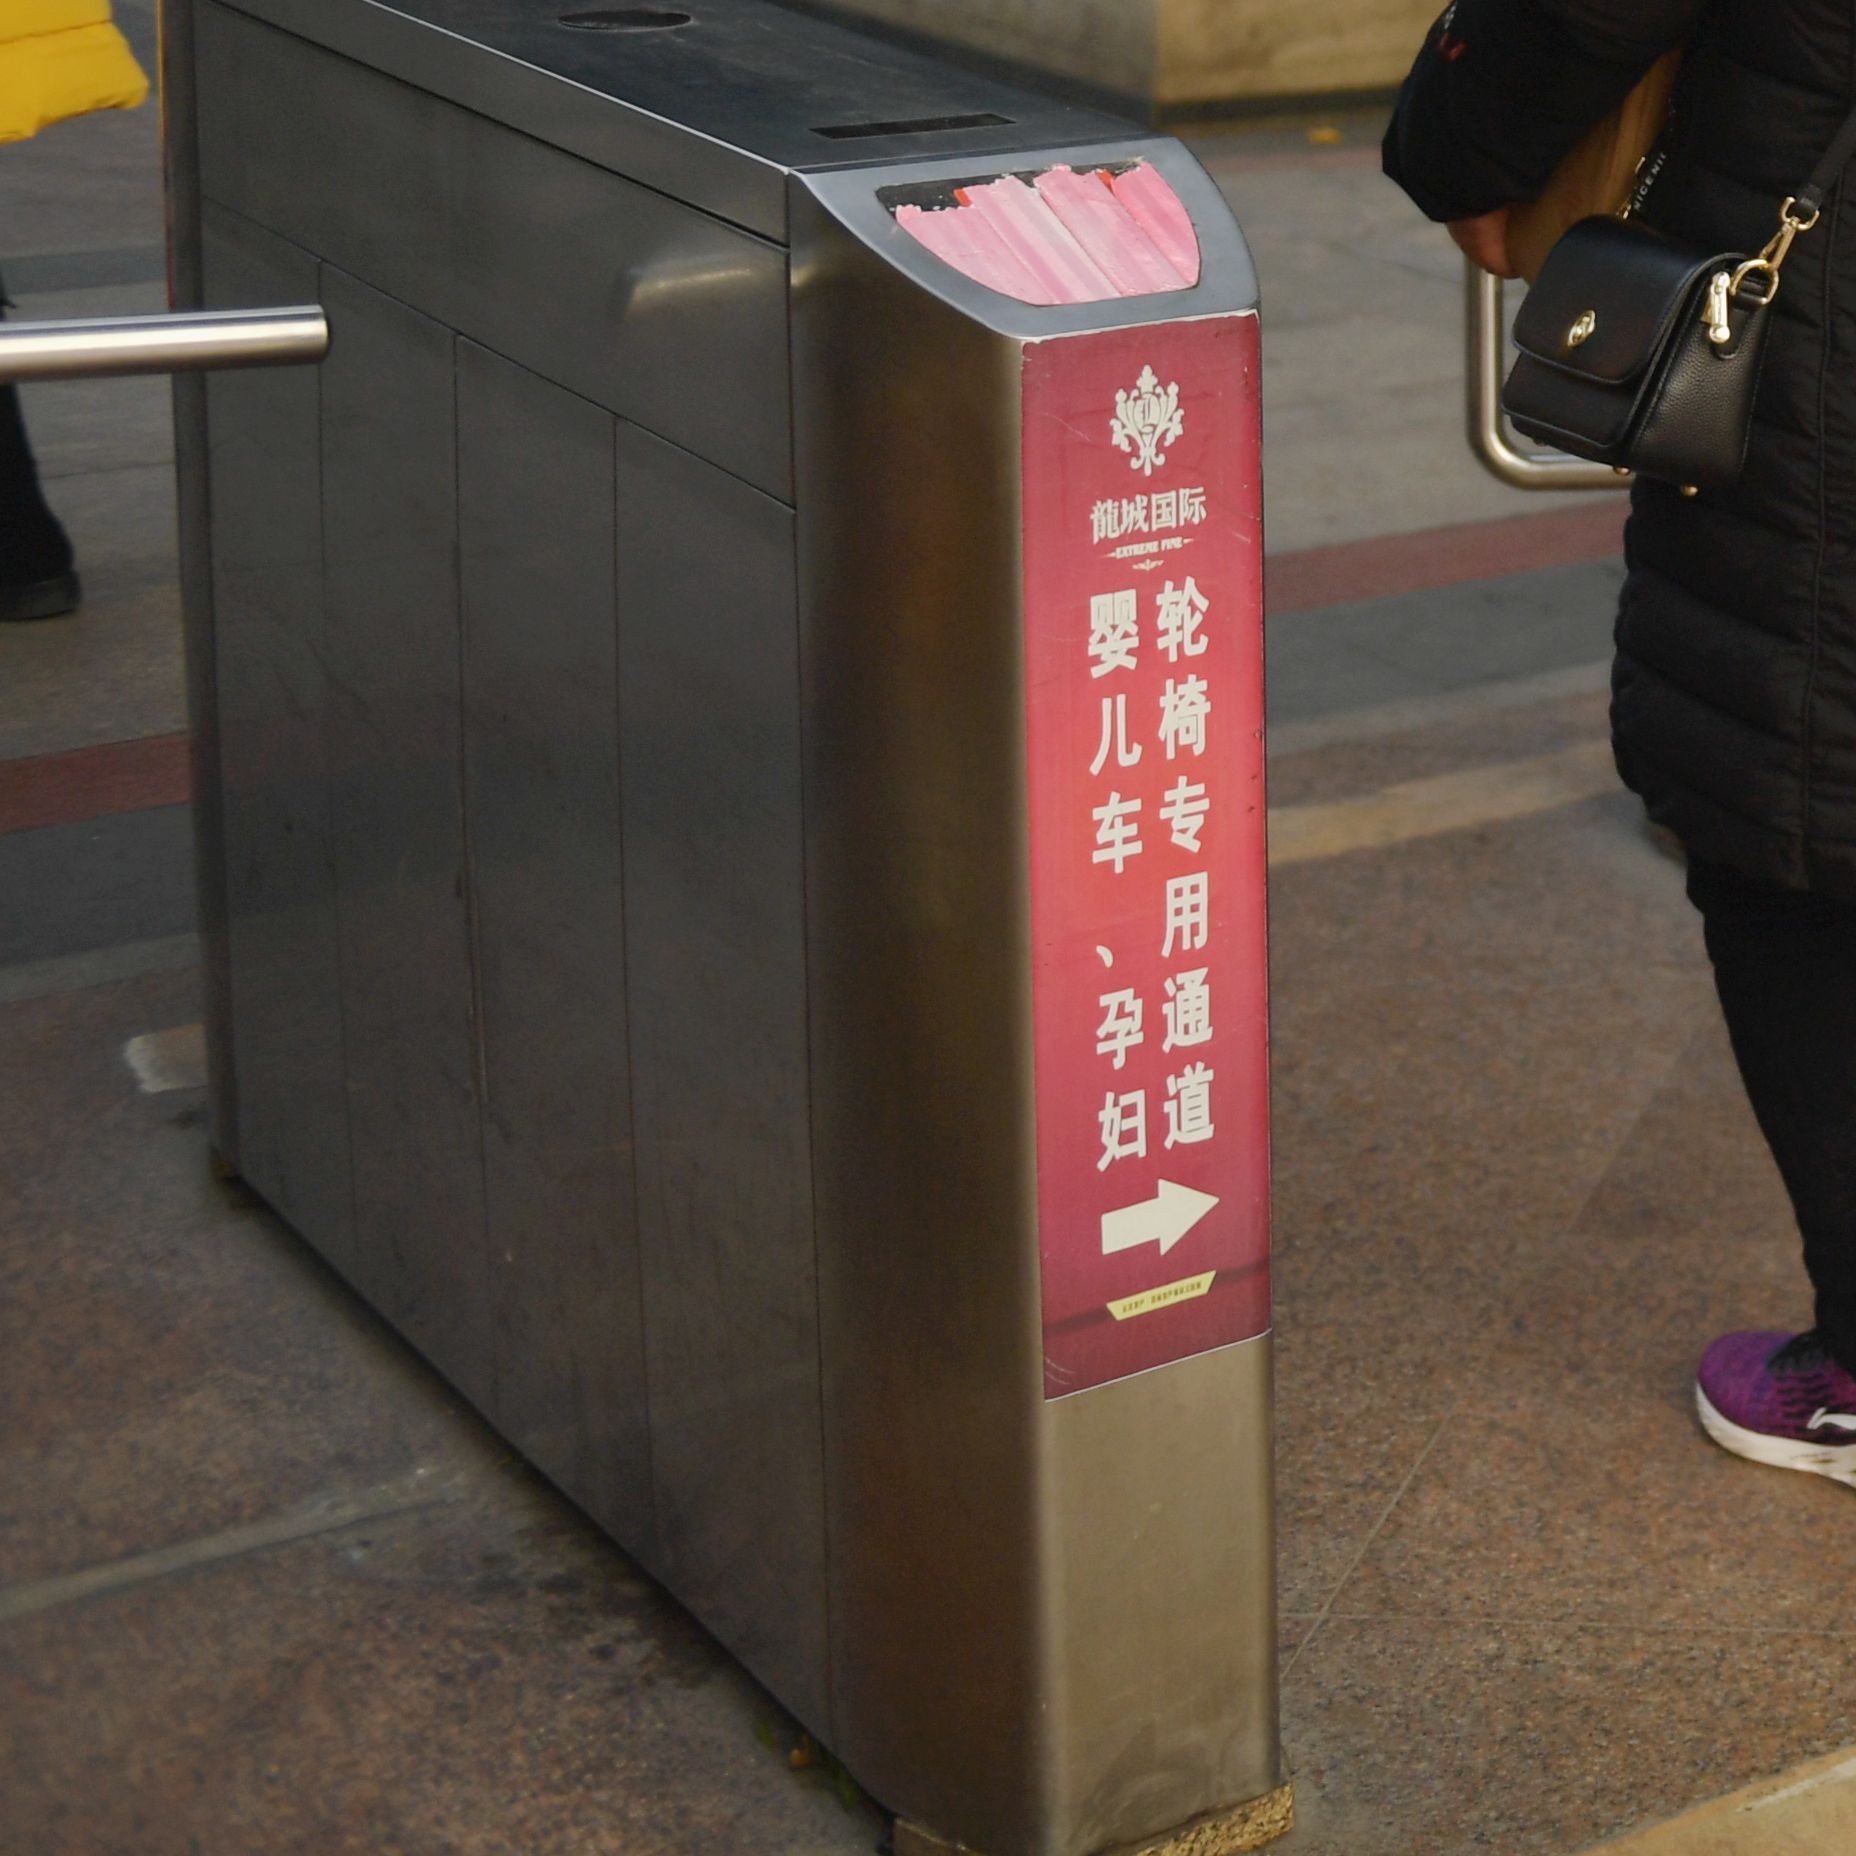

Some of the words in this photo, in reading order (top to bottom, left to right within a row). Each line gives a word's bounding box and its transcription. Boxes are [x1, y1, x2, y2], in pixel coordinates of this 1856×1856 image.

[1087, 587, 1147, 1173] 婴儿车、孕妇
[1155, 575, 1216, 1151] 轮椅专用通道
